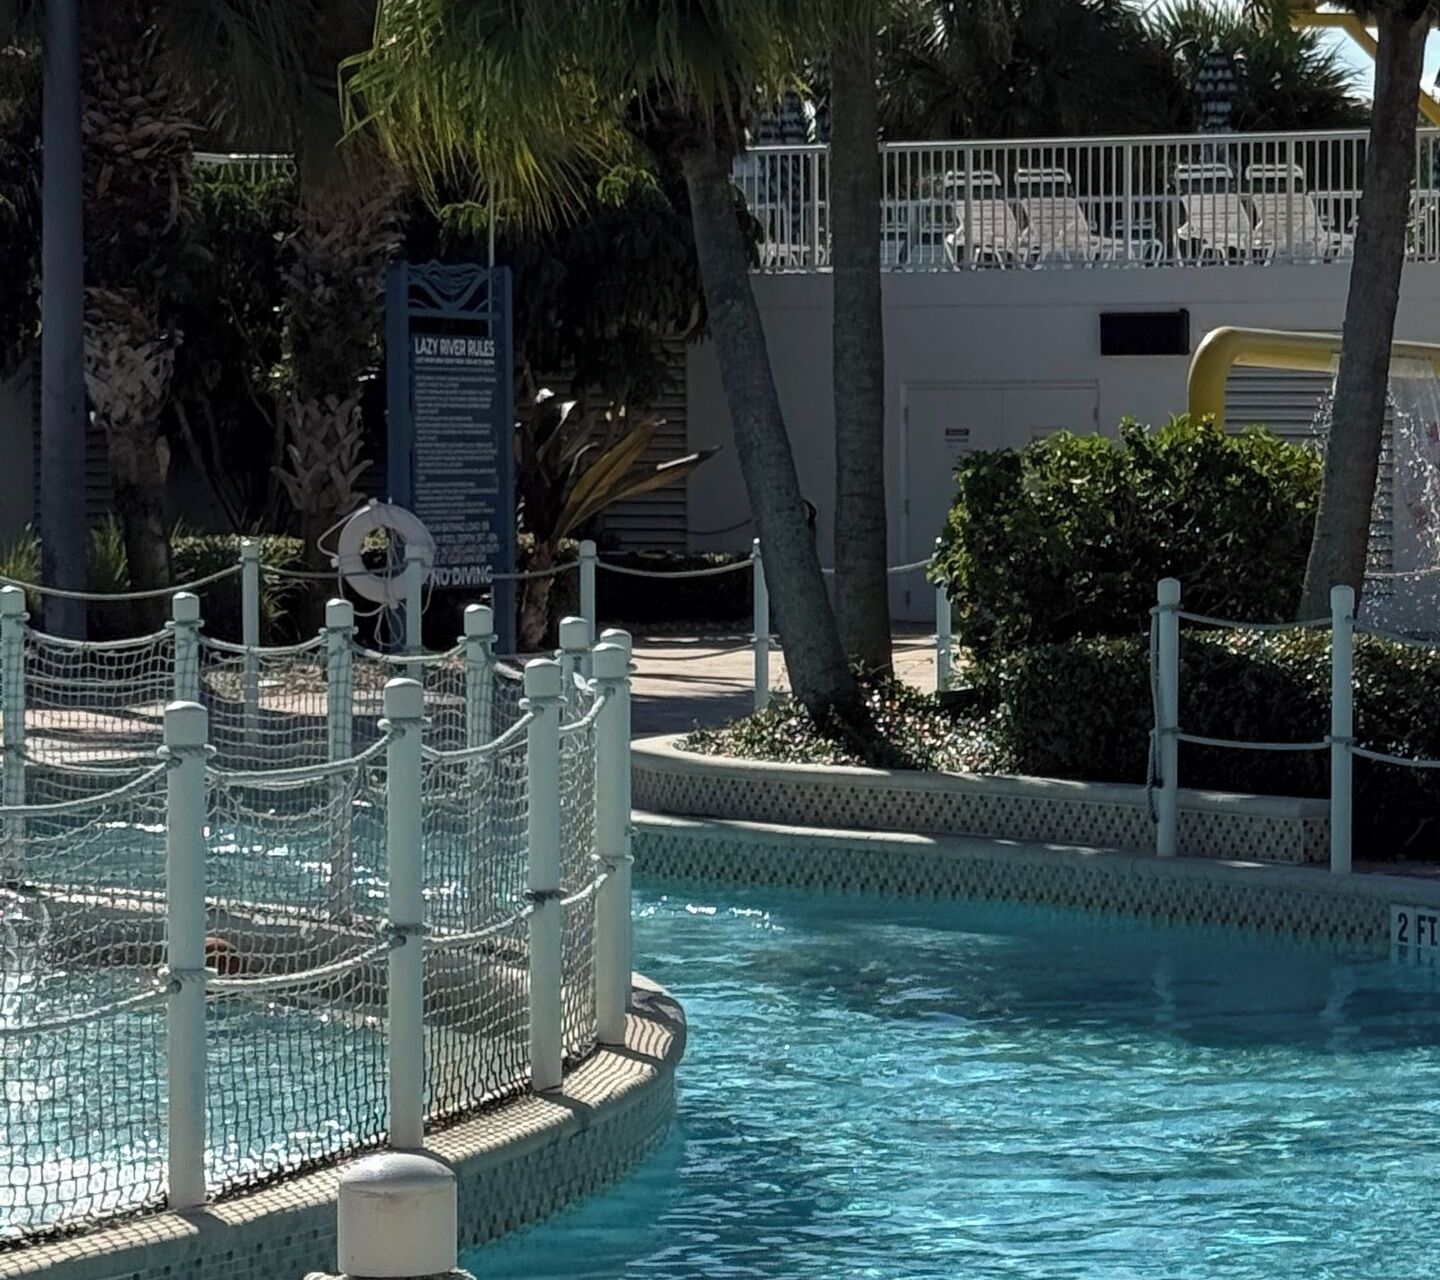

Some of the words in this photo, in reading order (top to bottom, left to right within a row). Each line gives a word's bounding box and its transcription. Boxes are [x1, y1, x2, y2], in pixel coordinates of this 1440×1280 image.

[414, 337, 438, 355] LAZY
[440, 338, 466, 356] RIVER
[467, 339, 495, 357] RULES
[431, 567, 450, 586] NO
[452, 565, 494, 586] DIVING
[1397, 912, 1409, 943] 2
[1417, 914, 1438, 946] FT.
